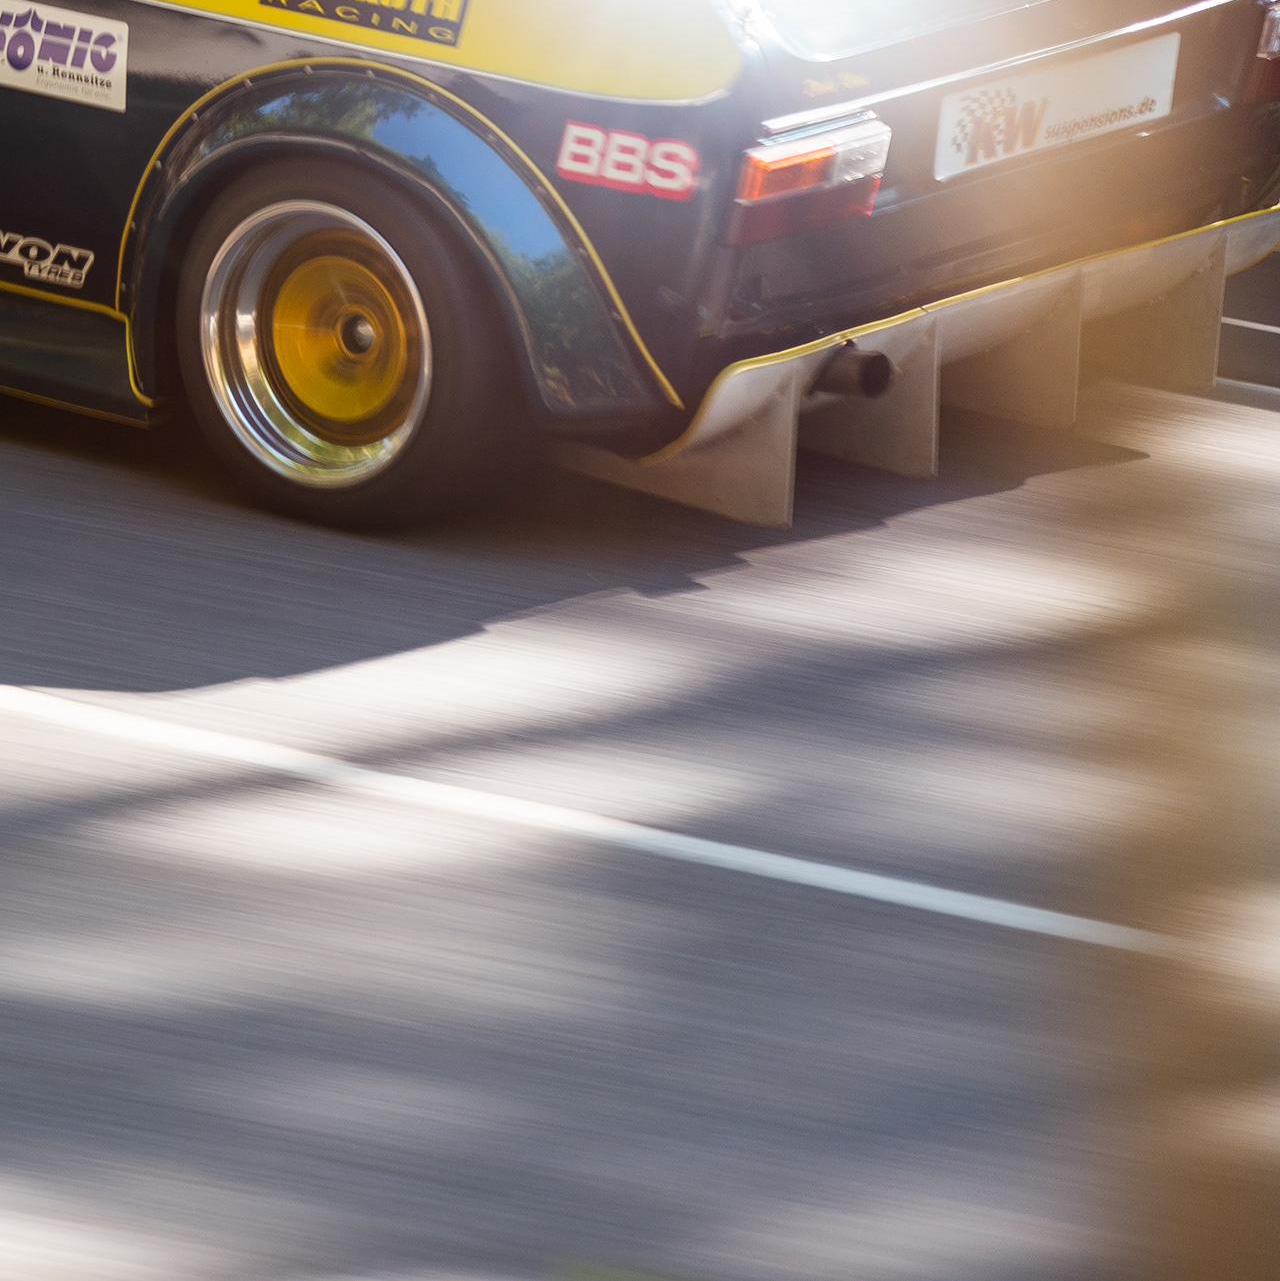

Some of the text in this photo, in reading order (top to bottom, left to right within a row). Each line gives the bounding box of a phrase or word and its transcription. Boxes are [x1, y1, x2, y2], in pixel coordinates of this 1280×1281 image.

[52, 65, 113, 89] Rennsitze
[964, 94, 1158, 167] KW suspensions.de
[556, 122, 698, 192] BBS
[26, 263, 86, 283] TYRES
